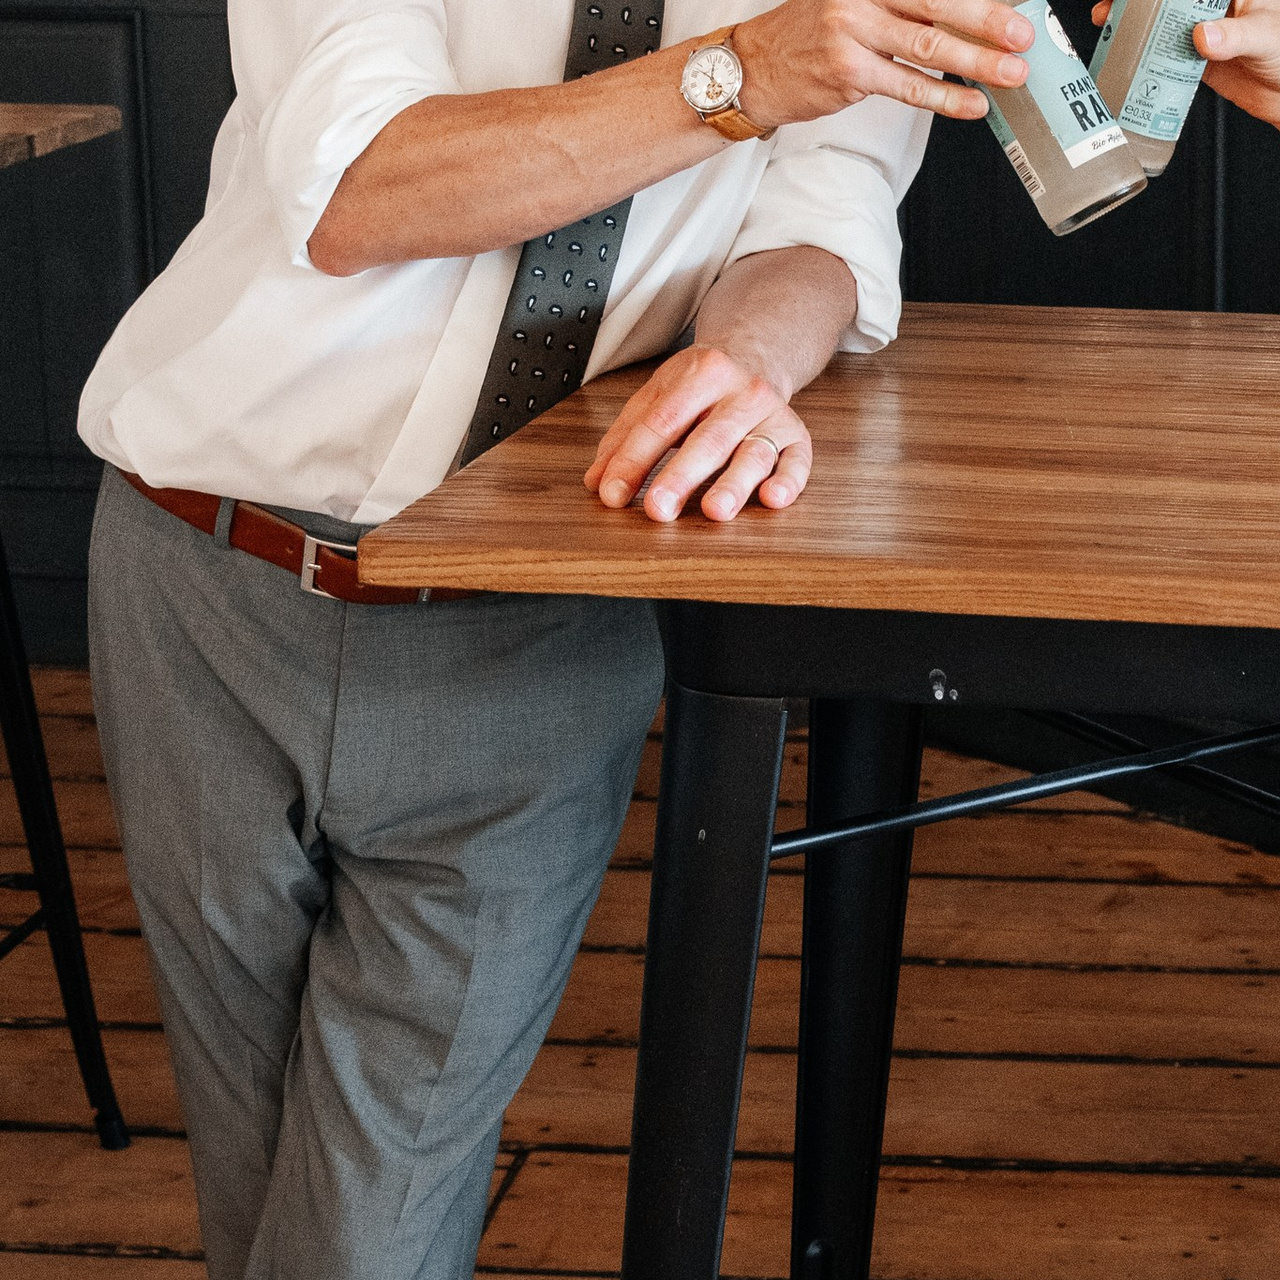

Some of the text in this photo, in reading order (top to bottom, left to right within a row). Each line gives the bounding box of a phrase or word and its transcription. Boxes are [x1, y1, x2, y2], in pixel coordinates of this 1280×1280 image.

[1060, 76, 1096, 101] FRANZ
[1135, 99, 1154, 109] VEGAN
[1091, 140, 1106, 150] Bio
